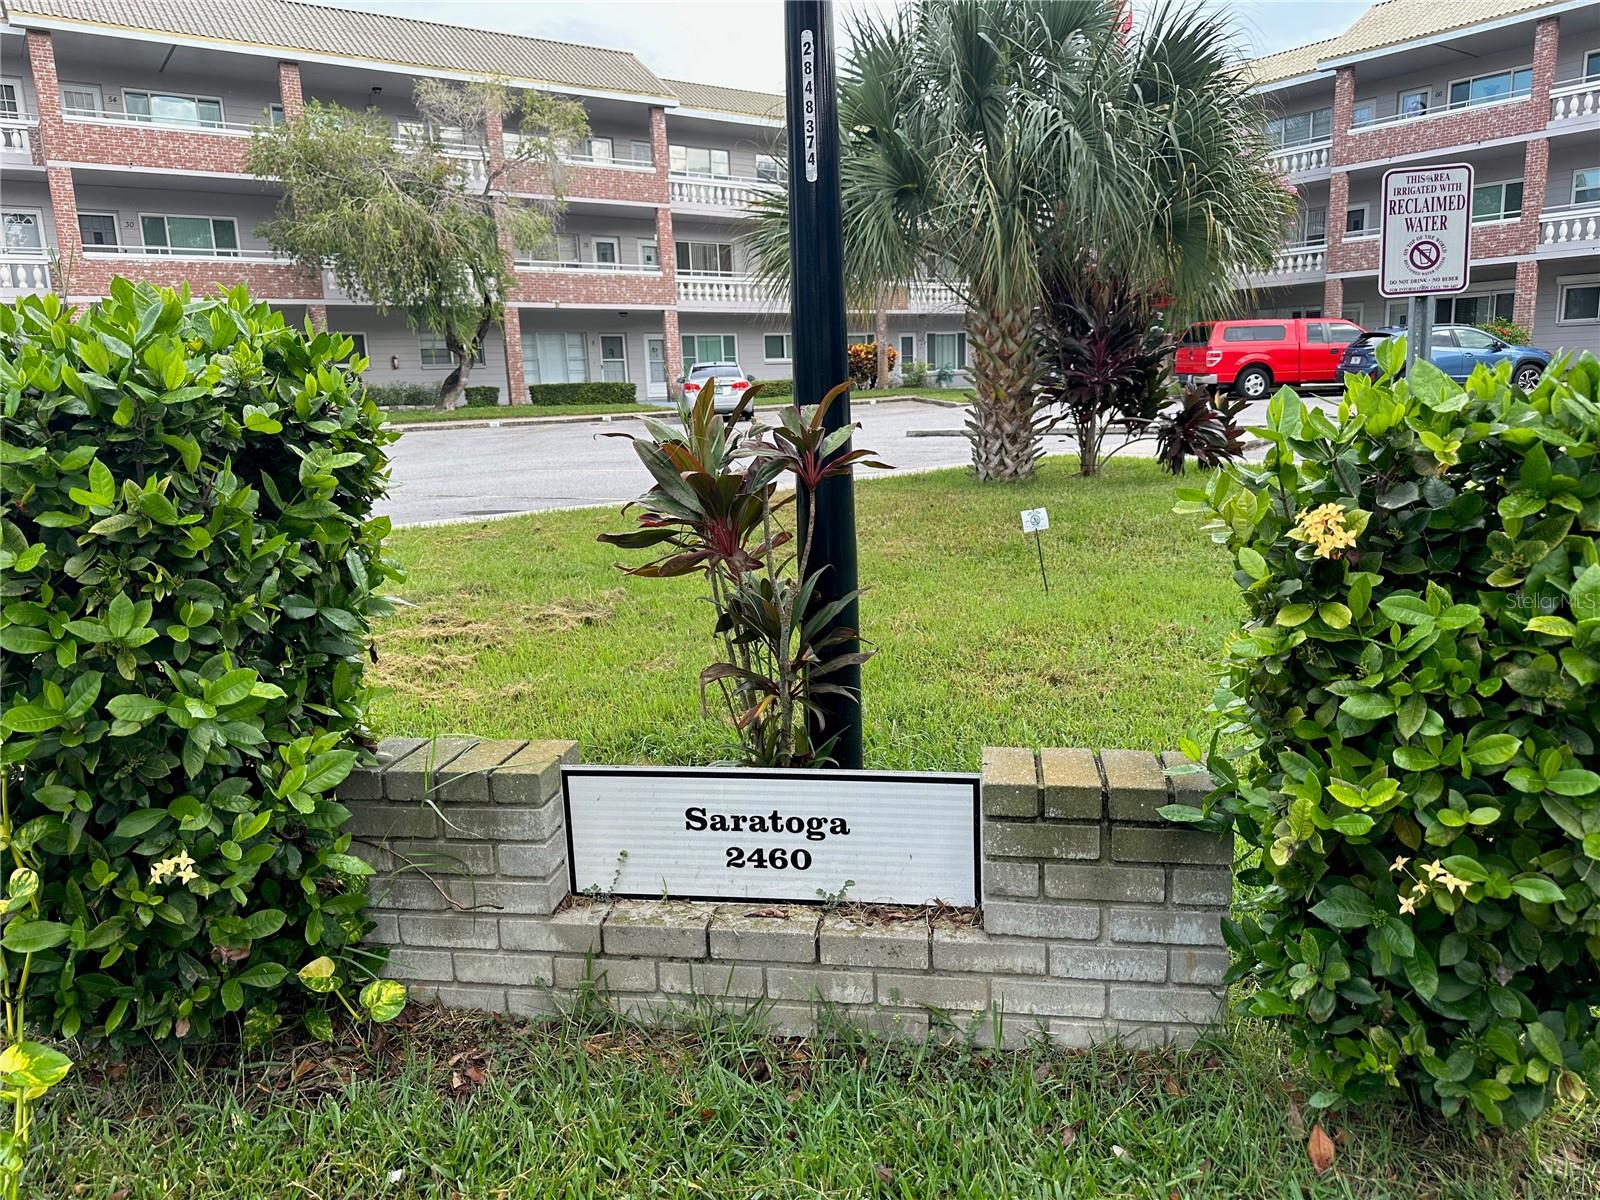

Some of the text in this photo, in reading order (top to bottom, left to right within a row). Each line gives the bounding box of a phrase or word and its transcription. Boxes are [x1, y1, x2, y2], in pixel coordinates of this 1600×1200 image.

[108, 95, 118, 103] 54
[802, 41, 816, 166] 2848374
[1406, 172, 1450, 184] THIS AREA
[1393, 182, 1462, 196] IRRIGATED WITH
[1388, 194, 1466, 215] RECLAIMED
[1405, 215, 1448, 232] WATER
[685, 807, 850, 841] Saratoga
[726, 847, 812, 870] 2460
